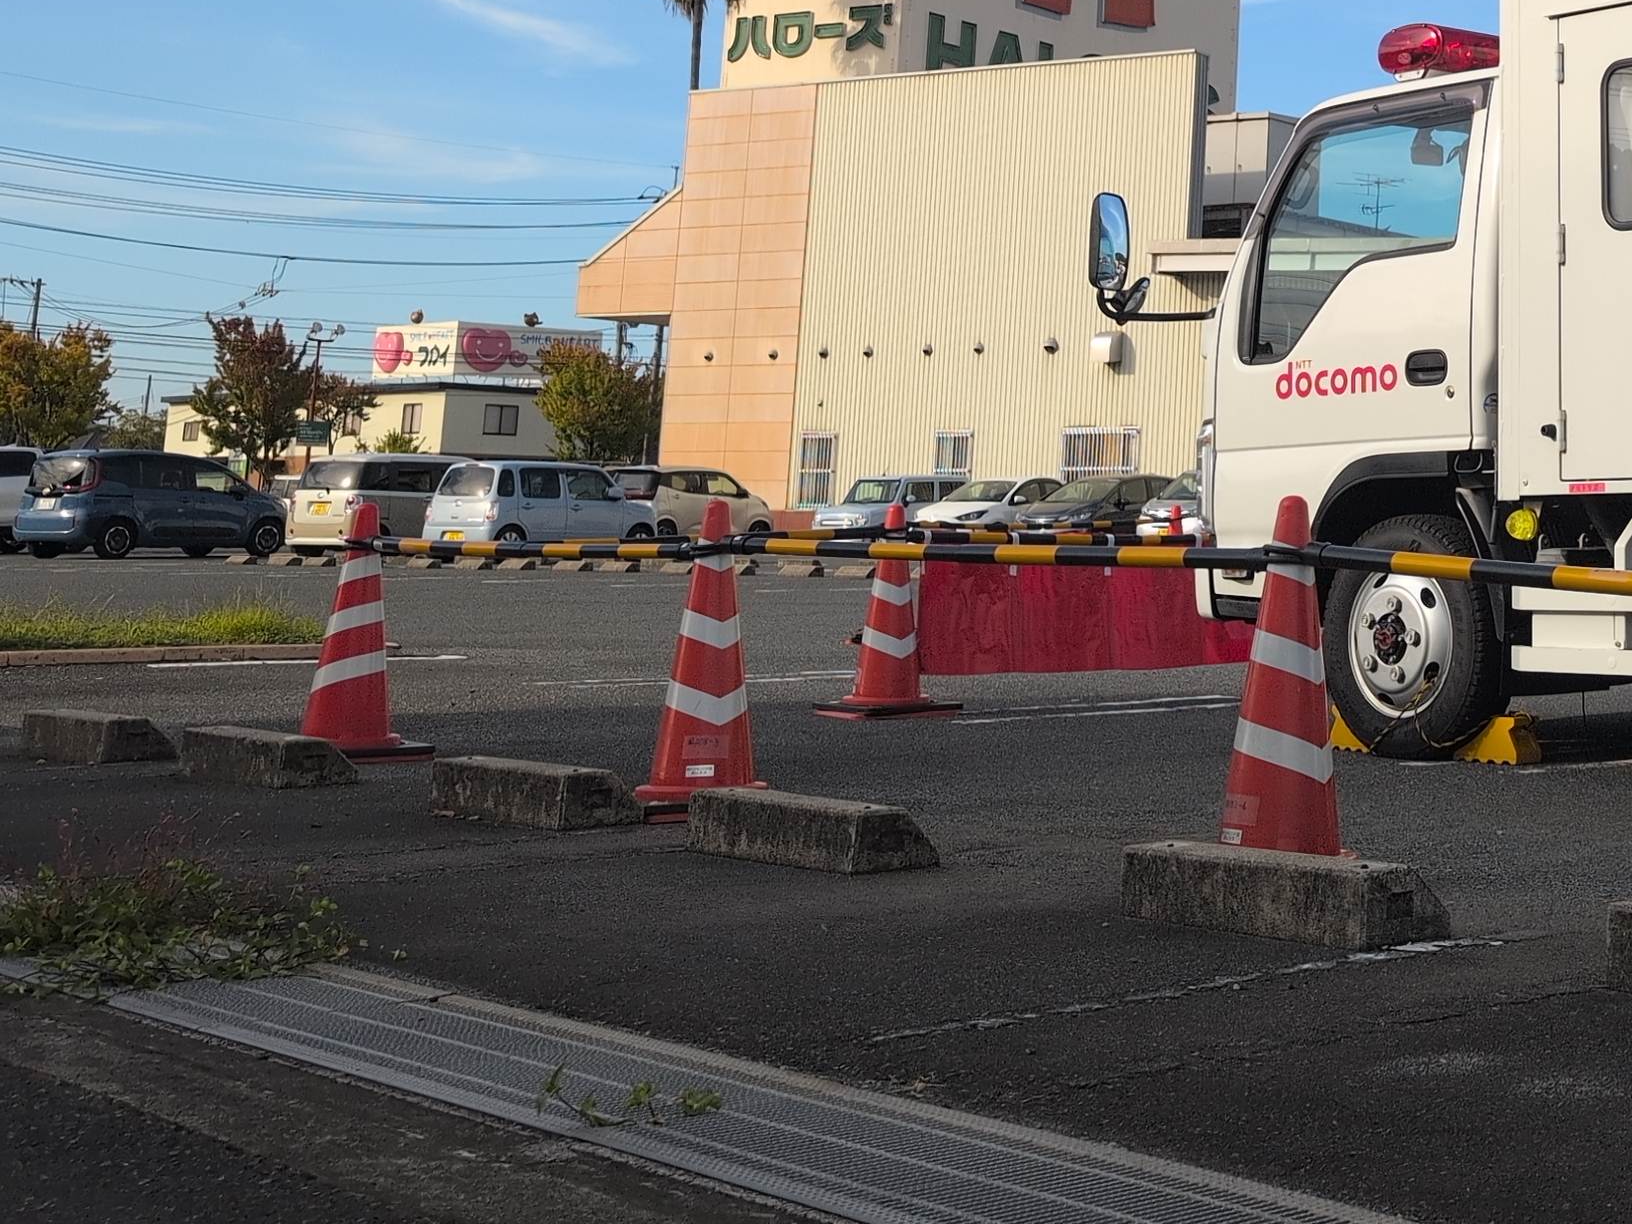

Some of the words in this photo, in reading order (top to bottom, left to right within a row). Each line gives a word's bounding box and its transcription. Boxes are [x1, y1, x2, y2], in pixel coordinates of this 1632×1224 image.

[727, 2, 894, 63] ハローズ
[1275, 361, 1398, 400] docomo
[1295, 359, 1313, 370] NTT
